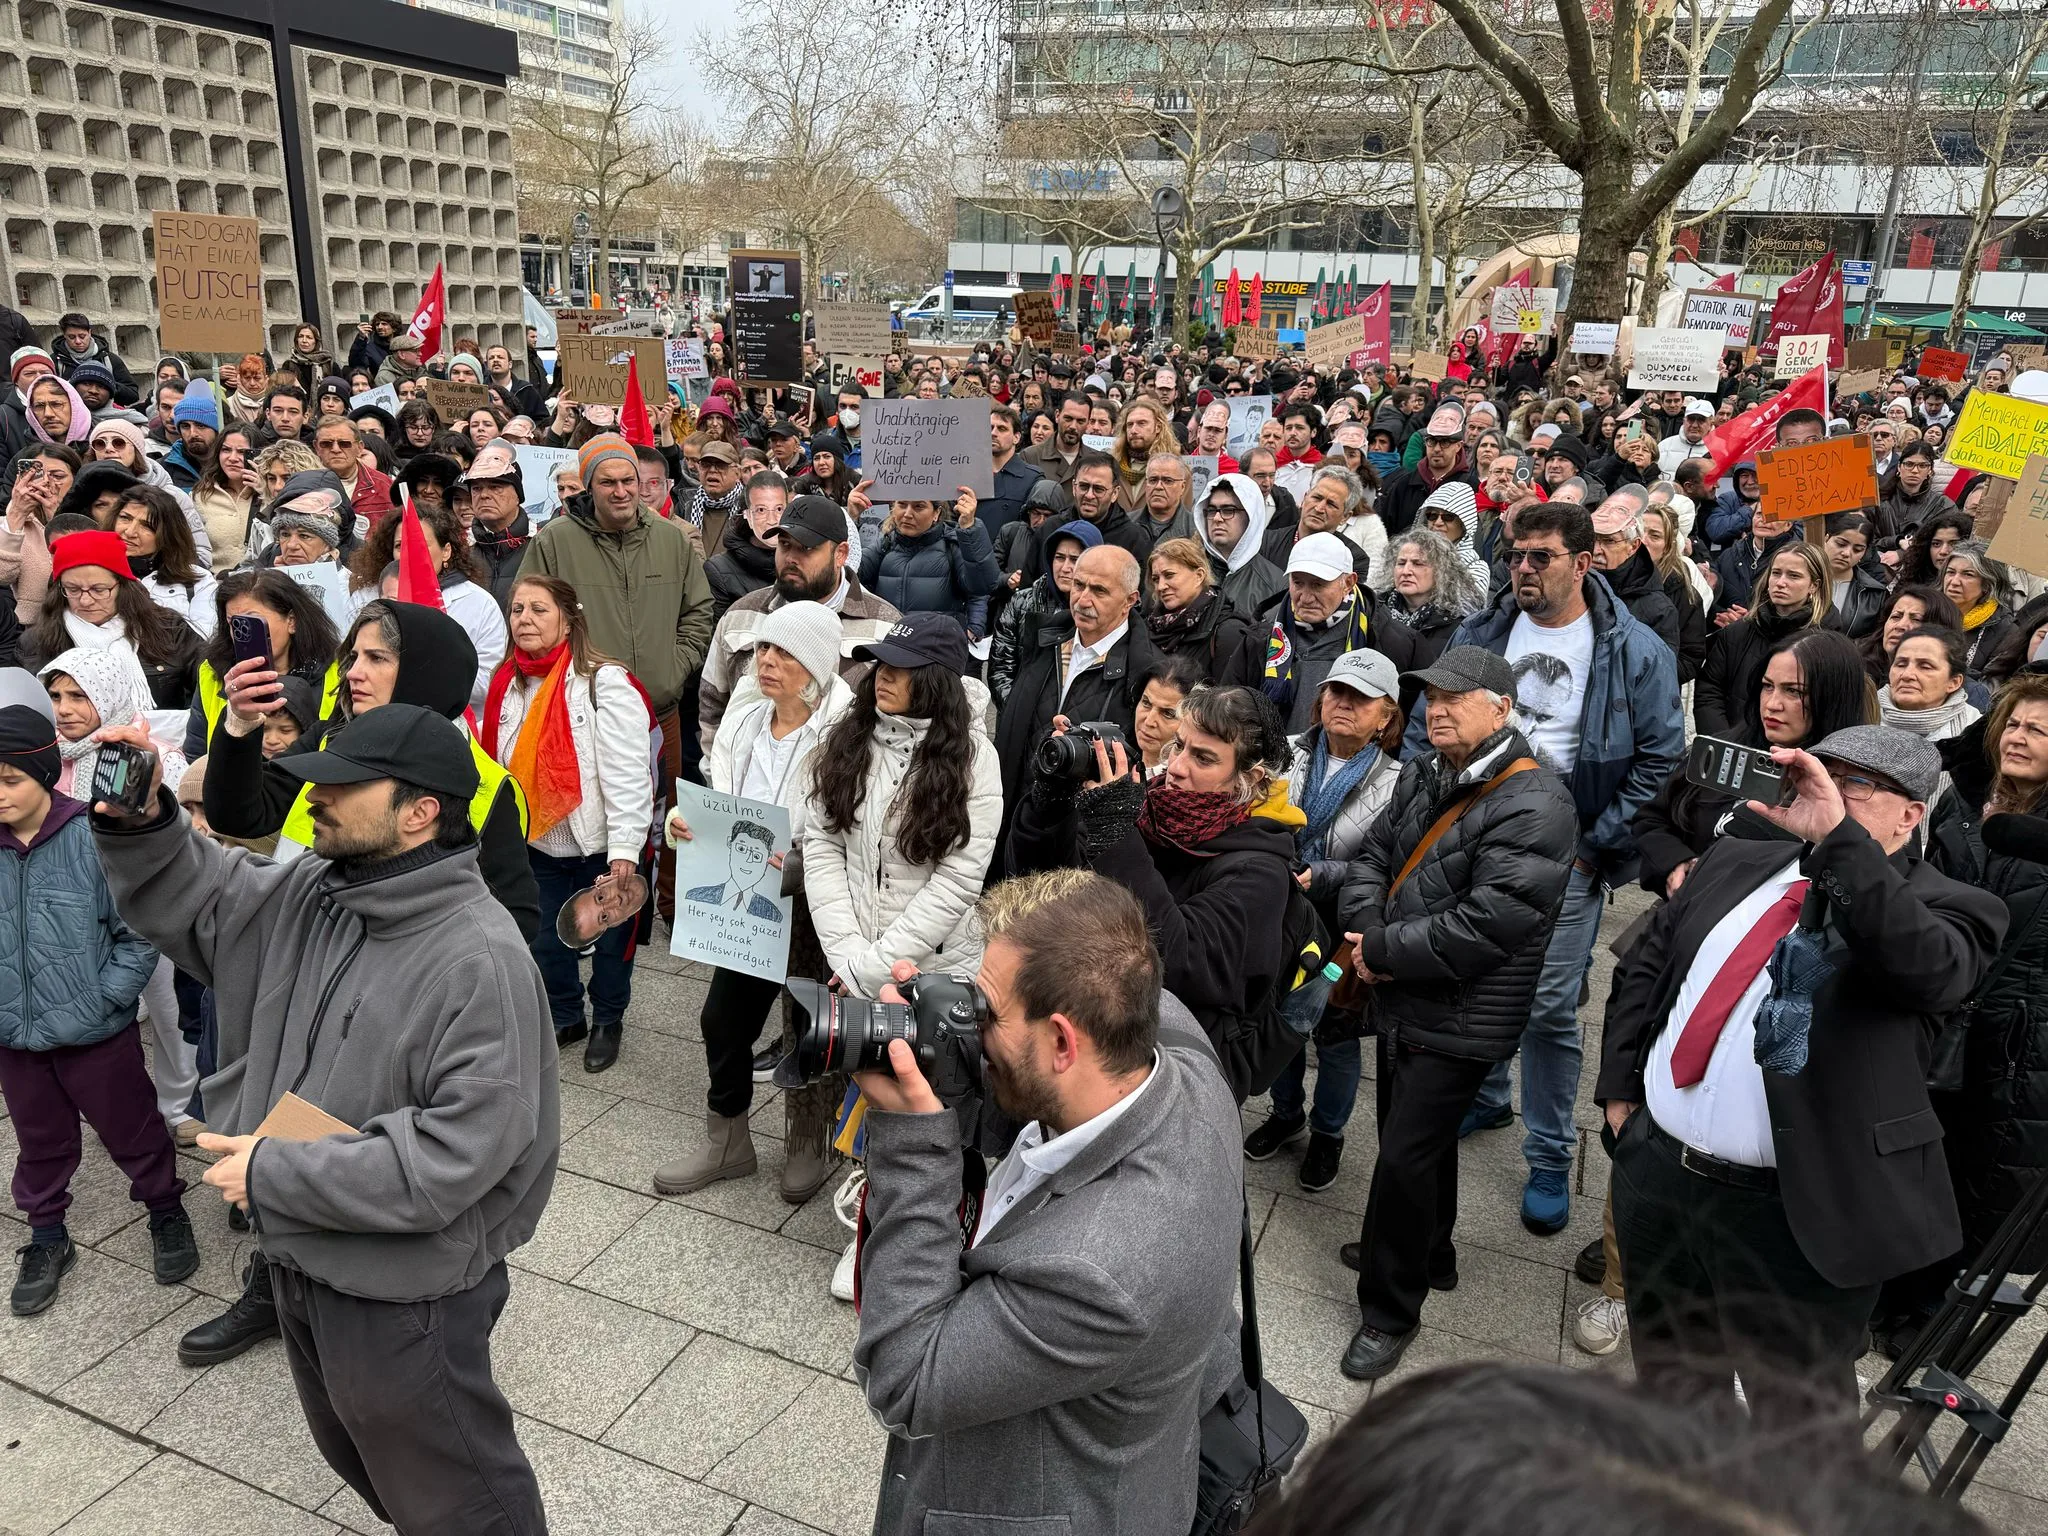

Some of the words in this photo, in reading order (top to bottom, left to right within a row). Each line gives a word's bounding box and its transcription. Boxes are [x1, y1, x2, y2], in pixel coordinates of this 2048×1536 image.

[160, 218, 258, 244] ERDOGAN
[159, 243, 199, 262] HAT
[207, 246, 257, 264] EINEN
[163, 265, 260, 300] PUTSCH
[163, 303, 260, 323] GEMACHT
[1688, 299, 1728, 316] DICTATOR
[1732, 303, 1753, 318] FALL
[2004, 310, 2026, 322] Lee
[1236, 328, 1254, 340] HAK
[1729, 324, 1750, 338] RISE
[1236, 340, 1278, 356] ADALET
[1785, 340, 1818, 357] 301
[570, 374, 656, 401] IMAMOU
[875, 406, 960, 436] Unabhängige
[871, 429, 923, 447] Justiz?
[873, 448, 908, 473] Klingt
[921, 454, 943, 466] wie
[950, 453, 970, 465] ein
[1777, 449, 1844, 478] EDISON
[1950, 447, 1983, 466] daha
[1986, 456, 2004, 471] da
[874, 468, 941, 486] Märchen!
[702, 794, 765, 821] üzülme
[688, 904, 707, 918] Her
[709, 912, 725, 927] şey
[729, 917, 746, 929] çok
[752, 923, 782, 940] güzel
[717, 929, 752, 946] olacak
[688, 937, 773, 969] #alleswirdgut
